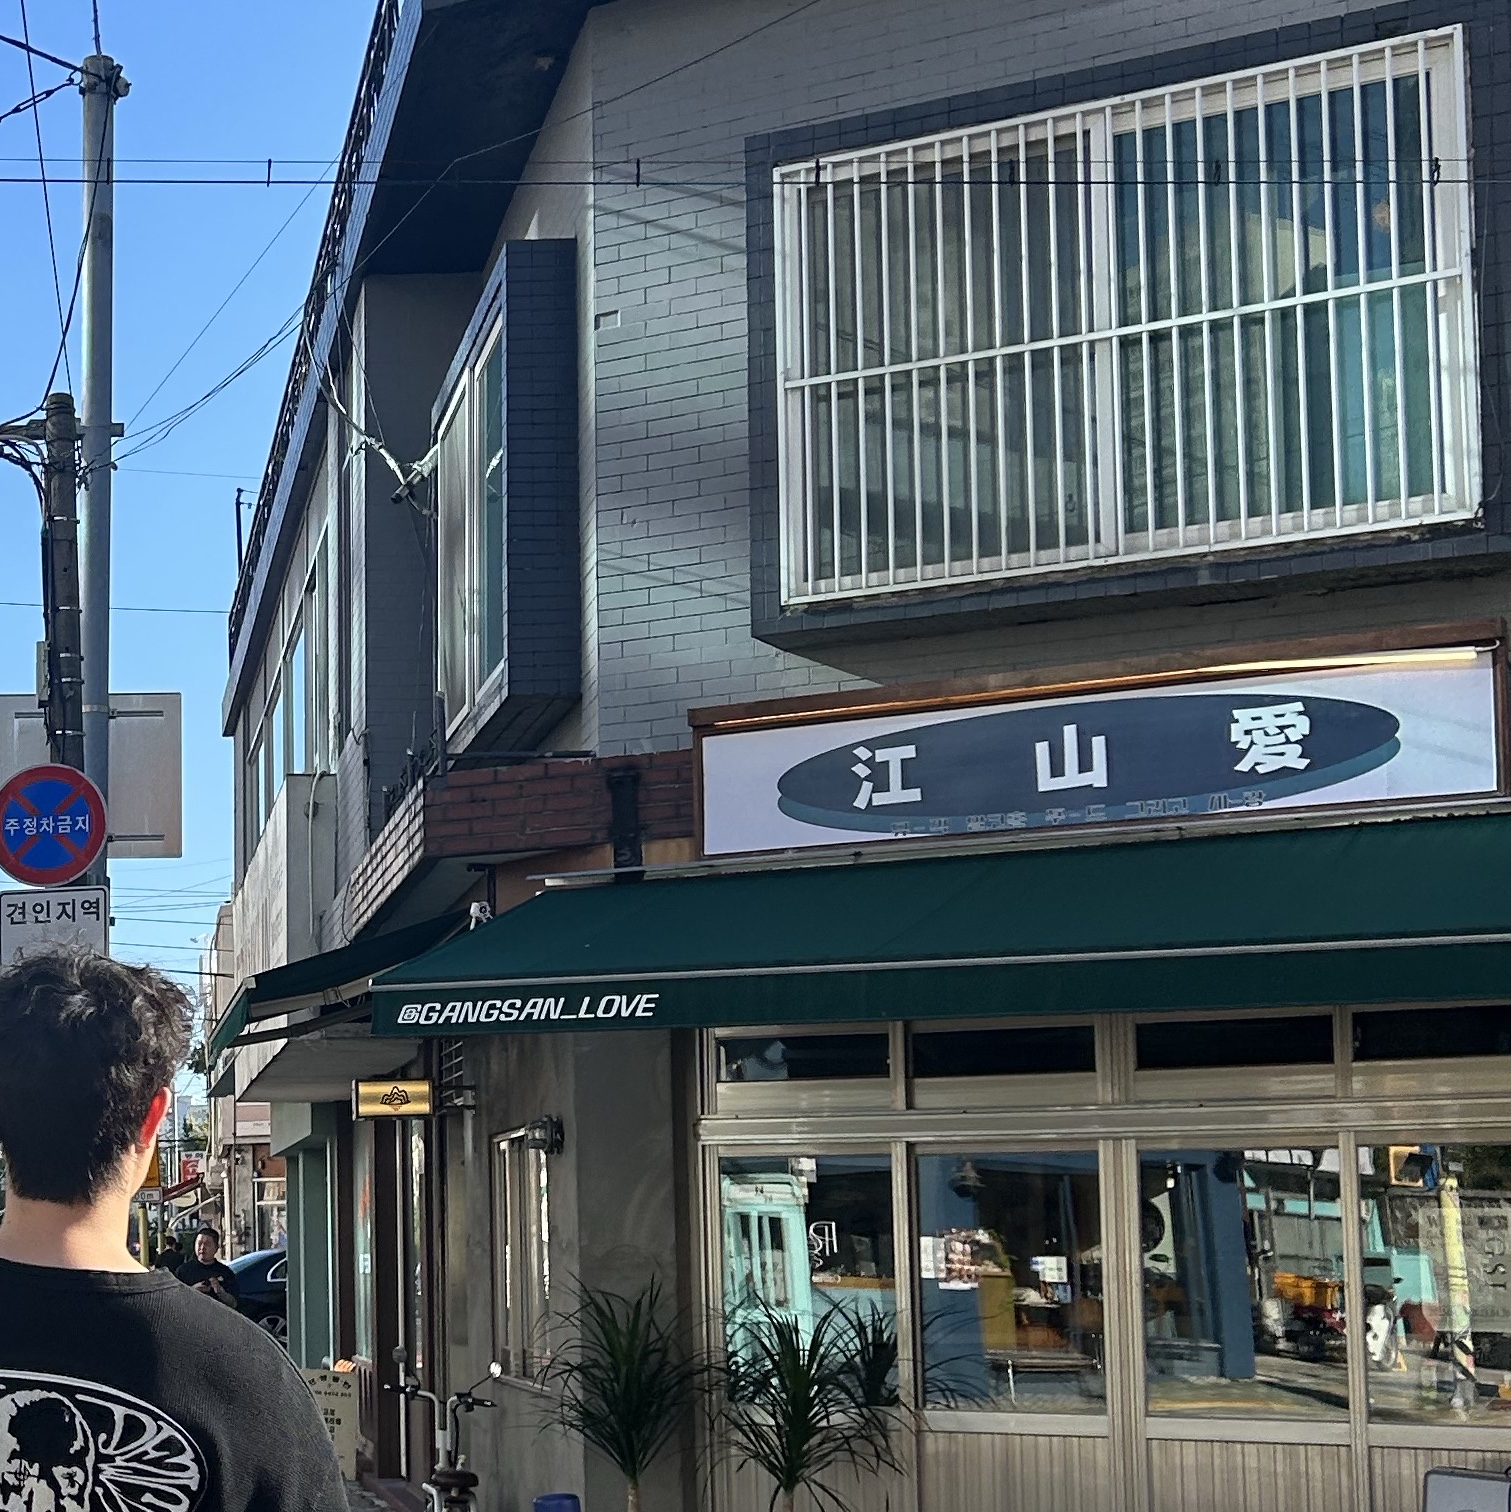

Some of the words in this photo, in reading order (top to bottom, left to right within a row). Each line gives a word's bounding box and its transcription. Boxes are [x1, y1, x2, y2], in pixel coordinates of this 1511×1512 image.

[851, 700, 1312, 811] 江山愛
[3, 813, 91, 837] 주정차금지
[5, 897, 101, 926] 견인지역
[397, 993, 660, 1025] @GANGSAN_LOVE
